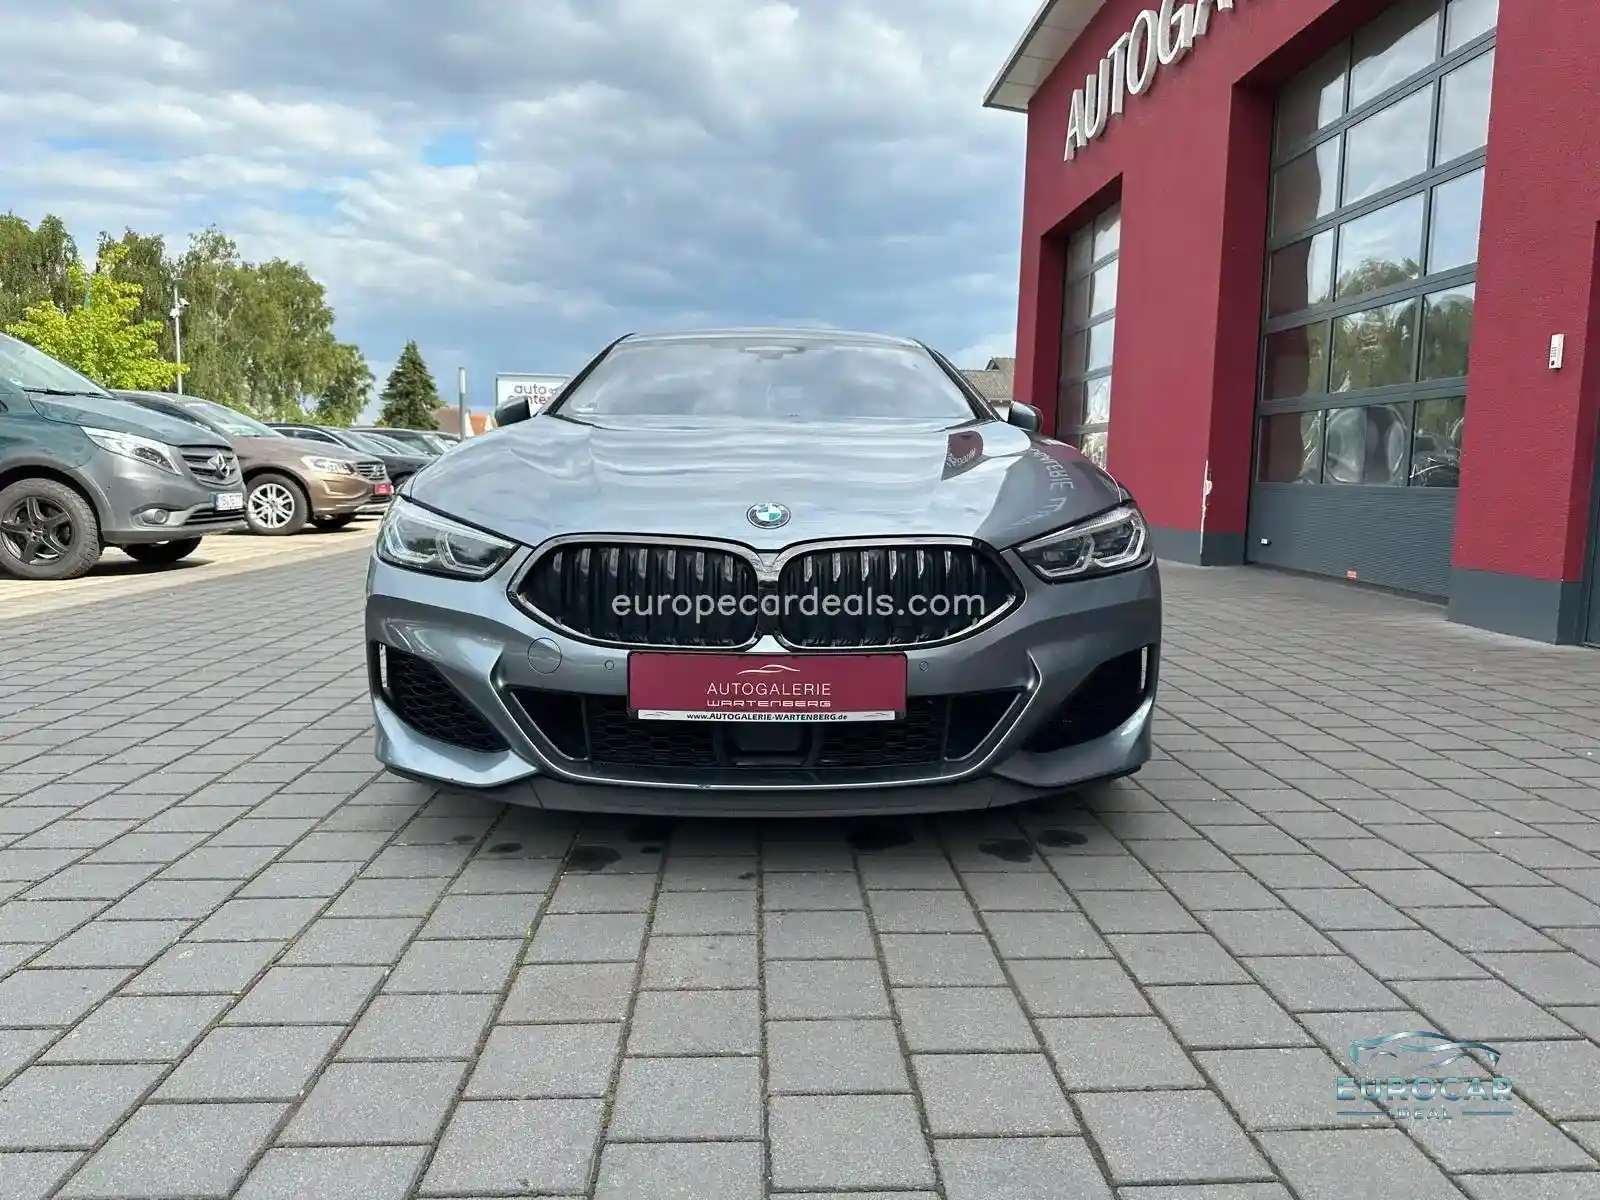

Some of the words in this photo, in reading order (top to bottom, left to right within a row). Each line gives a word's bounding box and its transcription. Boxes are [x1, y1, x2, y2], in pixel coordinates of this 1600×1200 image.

[514, 383, 547, 395] auto
[706, 682, 832, 696] AUTOGALERIE
[706, 700, 832, 708] WARTENBERG
[686, 712, 848, 722] www.AUTOGALERIE-WARTENBERG.de
